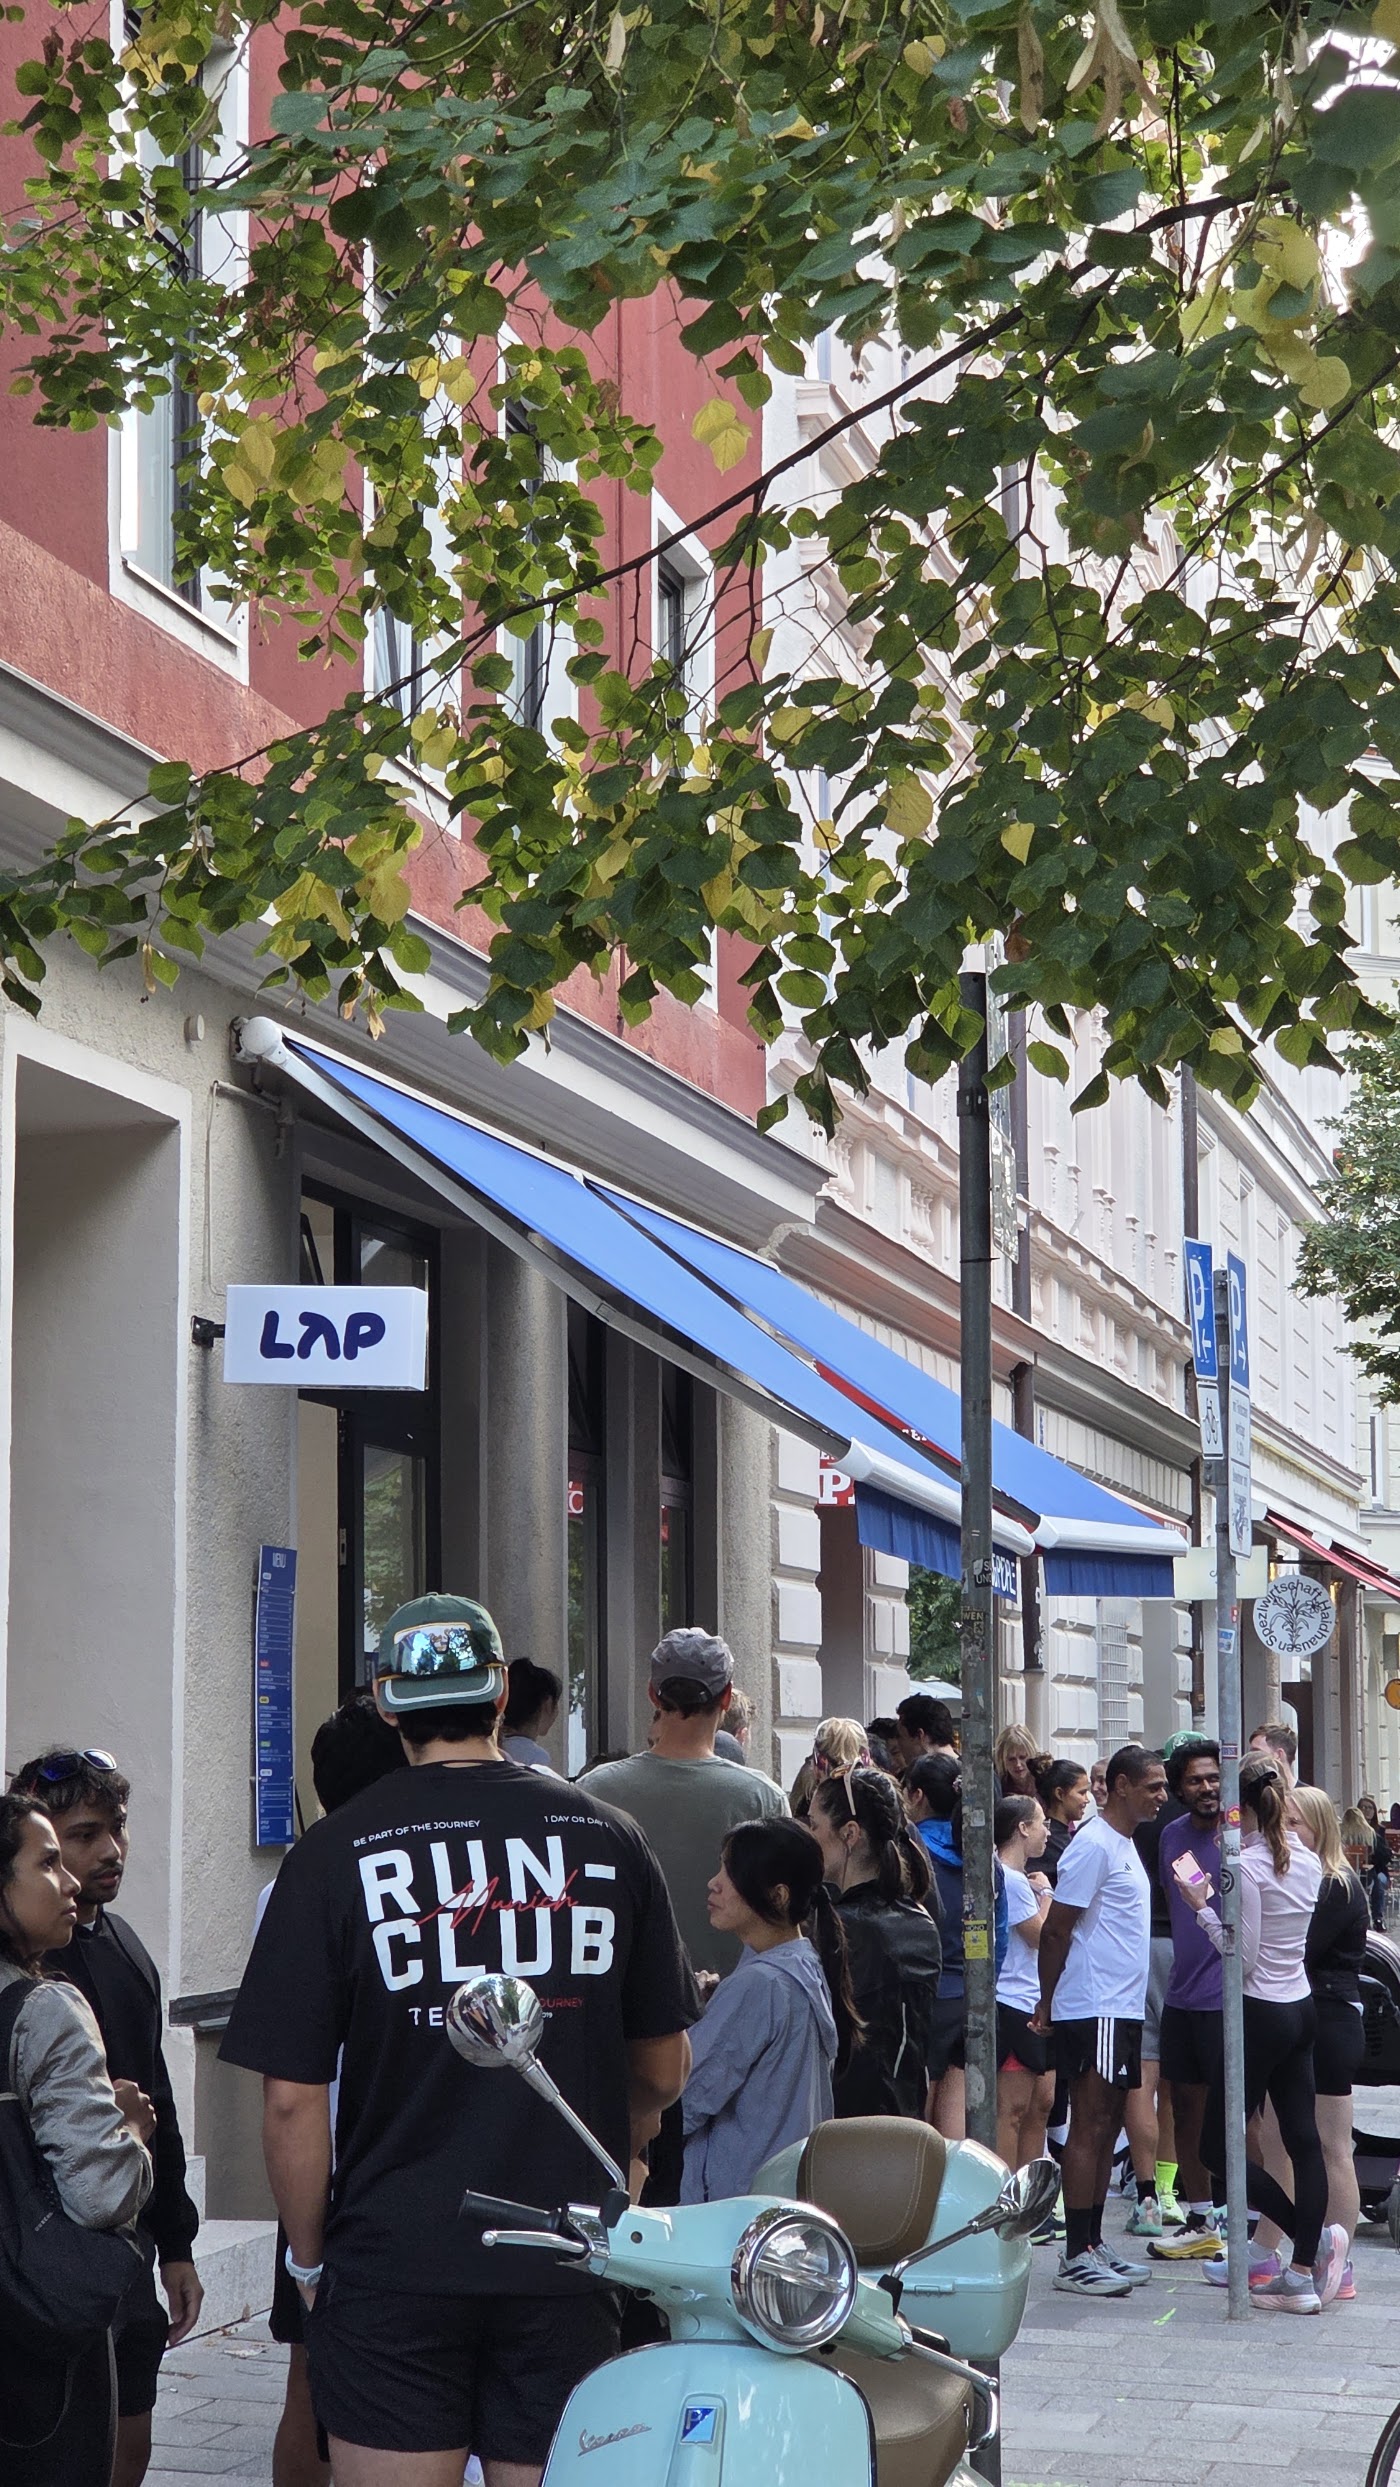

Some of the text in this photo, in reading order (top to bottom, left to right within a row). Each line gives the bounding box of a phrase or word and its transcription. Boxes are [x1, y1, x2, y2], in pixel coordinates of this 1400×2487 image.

[260, 1310, 386, 1361] LAP
[1257, 1579, 1332, 1653] Spezlwirtschaft Haidhausen
[353, 1820, 481, 1848] BE PART OF THE JOURNEY
[544, 1815, 549, 1823] 1
[550, 1814, 570, 1823] DAY
[571, 1815, 586, 1824] OR
[586, 1817, 603, 1827] DAY
[358, 1836, 616, 1922] RUN-
[412, 1869, 579, 1936] Munich
[372, 1905, 616, 1992] CLUB
[539, 1996, 584, 2008] OURNEY
